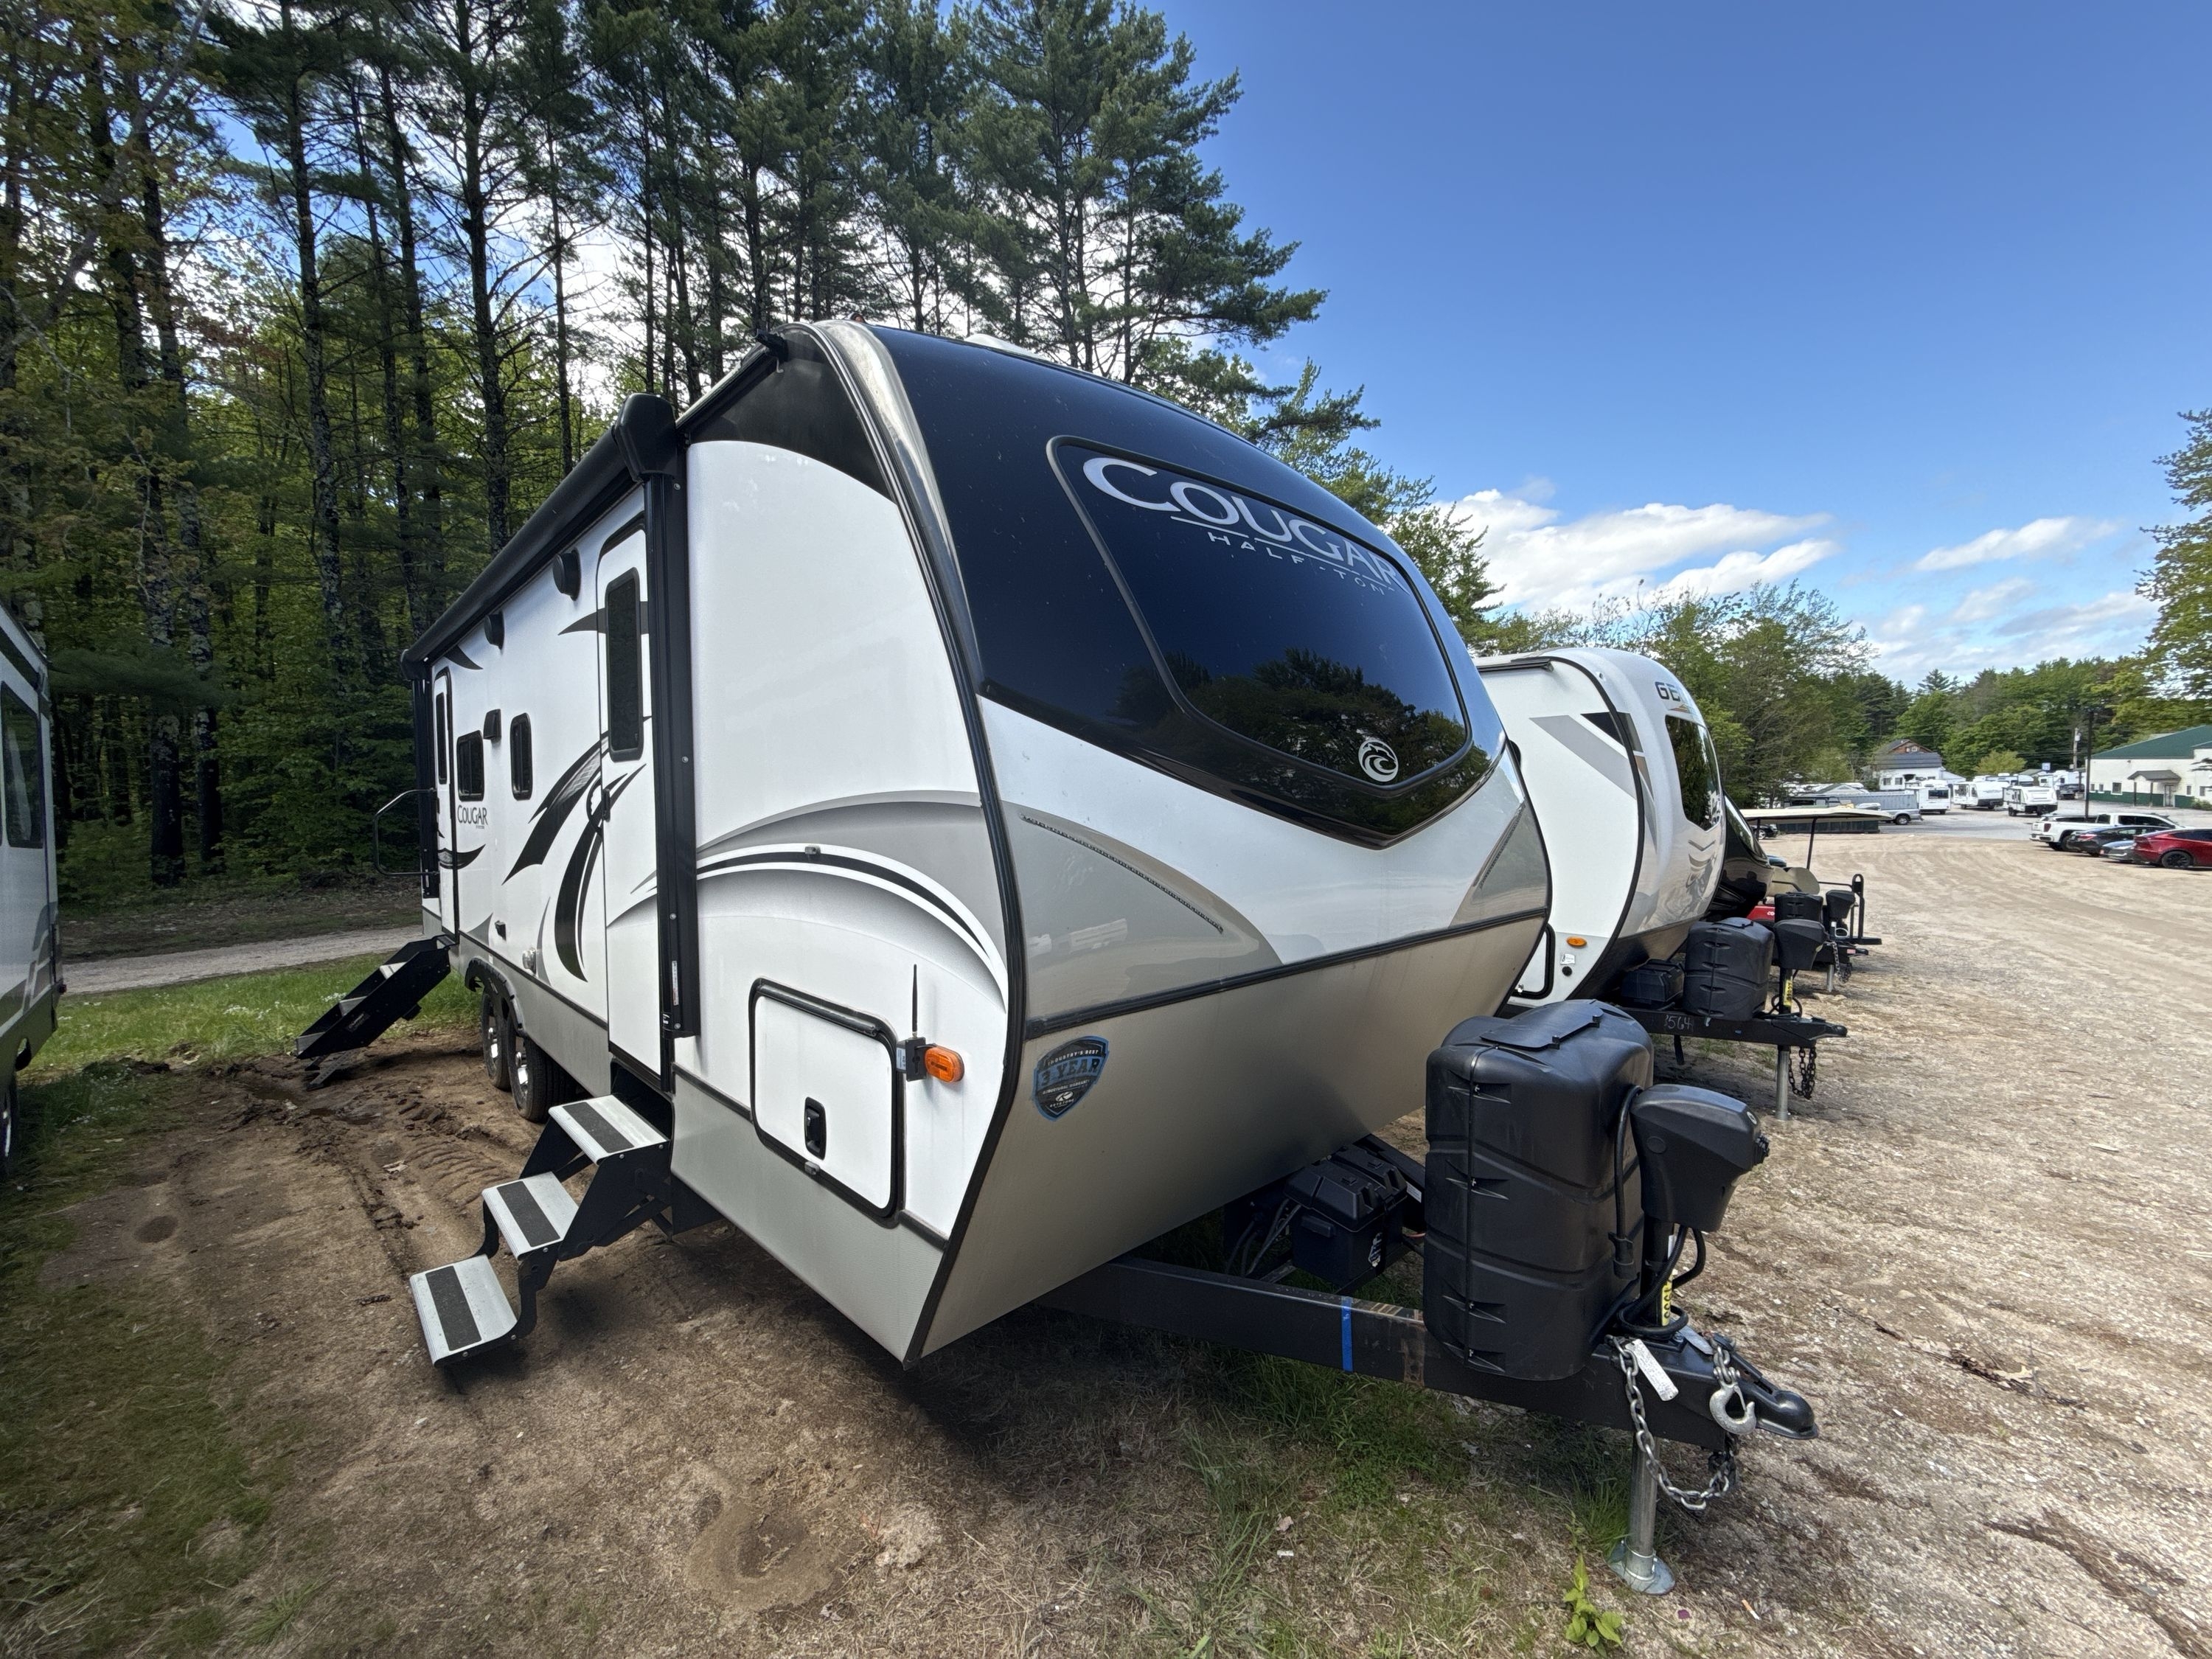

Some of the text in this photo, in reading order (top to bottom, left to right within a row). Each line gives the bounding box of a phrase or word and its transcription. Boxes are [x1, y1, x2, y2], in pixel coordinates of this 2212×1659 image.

[1083, 457, 1411, 595] COUGAR
[457, 804, 488, 825] COUGAR
[1056, 1058, 1101, 1079] YEAR
